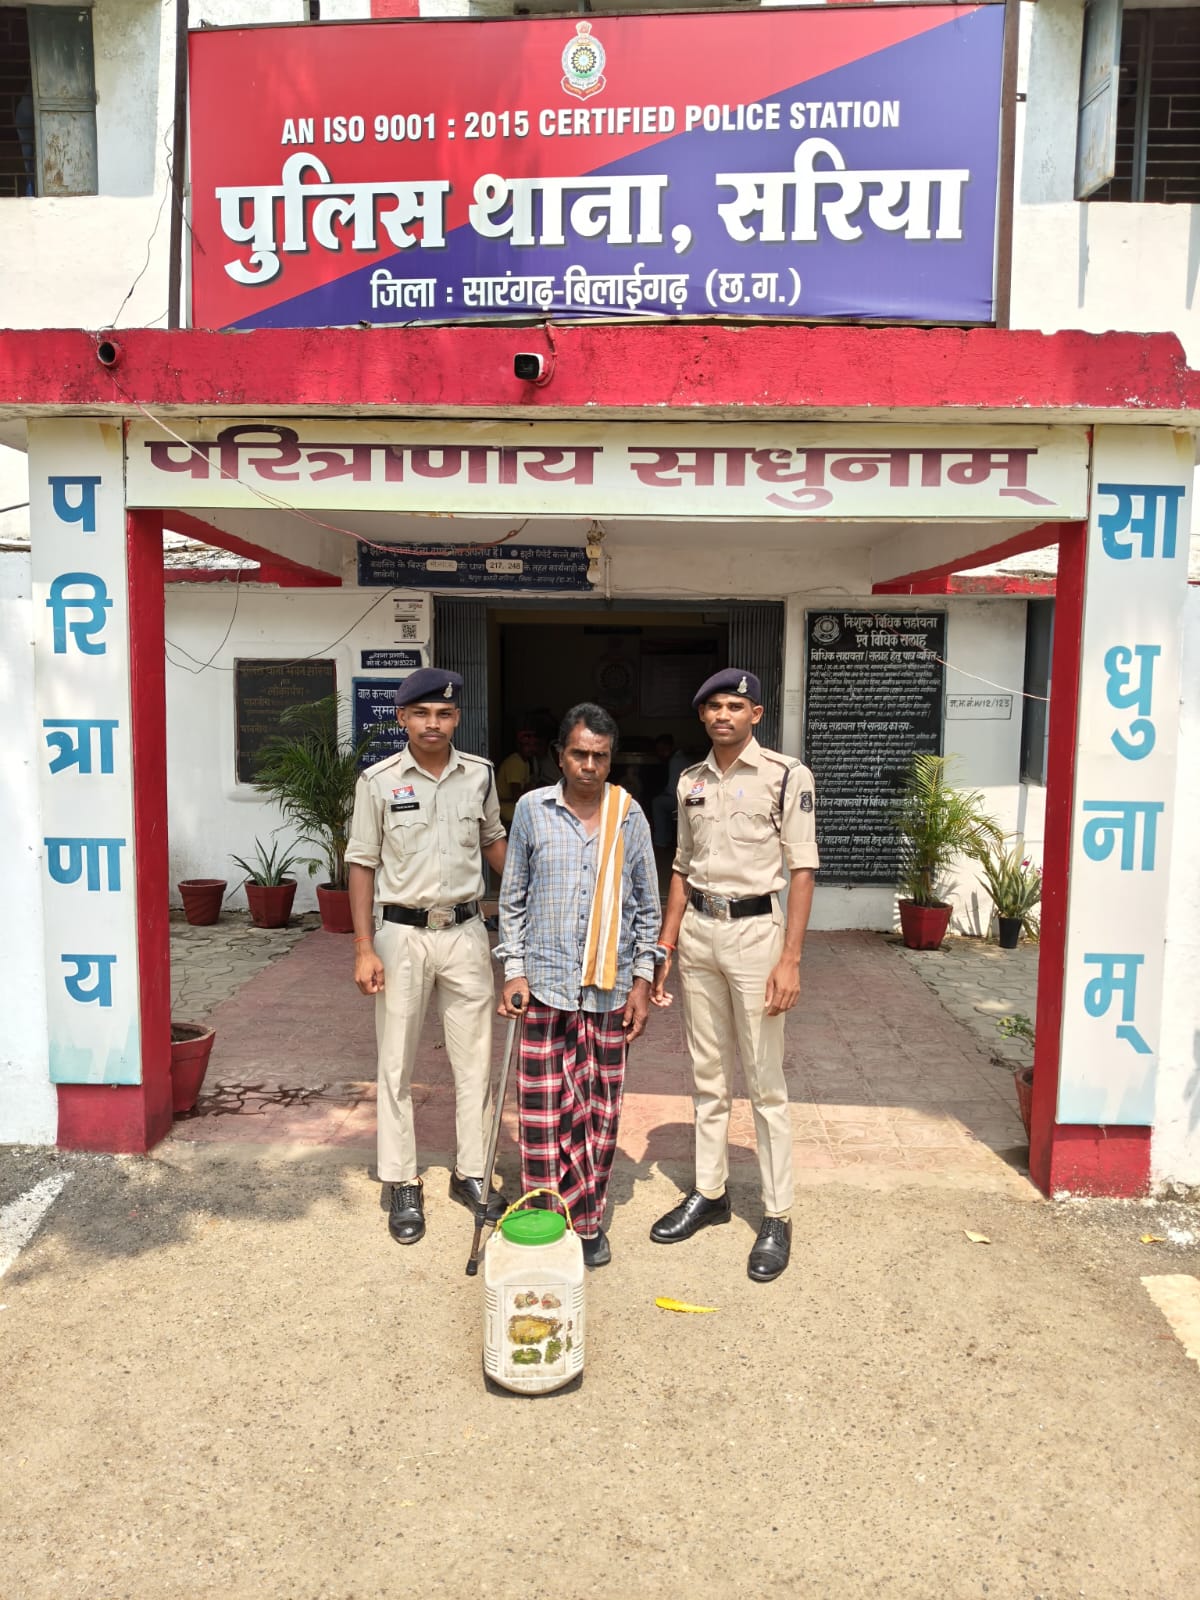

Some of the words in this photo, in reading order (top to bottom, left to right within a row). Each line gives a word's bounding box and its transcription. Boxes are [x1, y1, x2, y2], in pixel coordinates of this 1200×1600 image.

[281, 118, 315, 145] AN
[323, 115, 365, 143] ISO
[374, 113, 437, 142] 9001
[465, 110, 528, 139] 2015
[539, 105, 675, 136] CERTIFIED
[685, 102, 781, 133] POLICE
[789, 99, 901, 131] STATION
[215, 151, 450, 286] पुलिस
[468, 173, 694, 254] थाना,
[716, 136, 972, 243] सरिया
[369, 268, 437, 308] जिला
[462, 262, 690, 313] सारंगढ़-बिलाईगढ़
[705, 267, 802, 307] (छ.ग.)
[143, 424, 604, 485] परित्राणाय
[628, 446, 1058, 511] साधुनाम्
[42, 475, 127, 1008] परित्राणाय
[1081, 483, 1186, 1054] साधुनाम्
